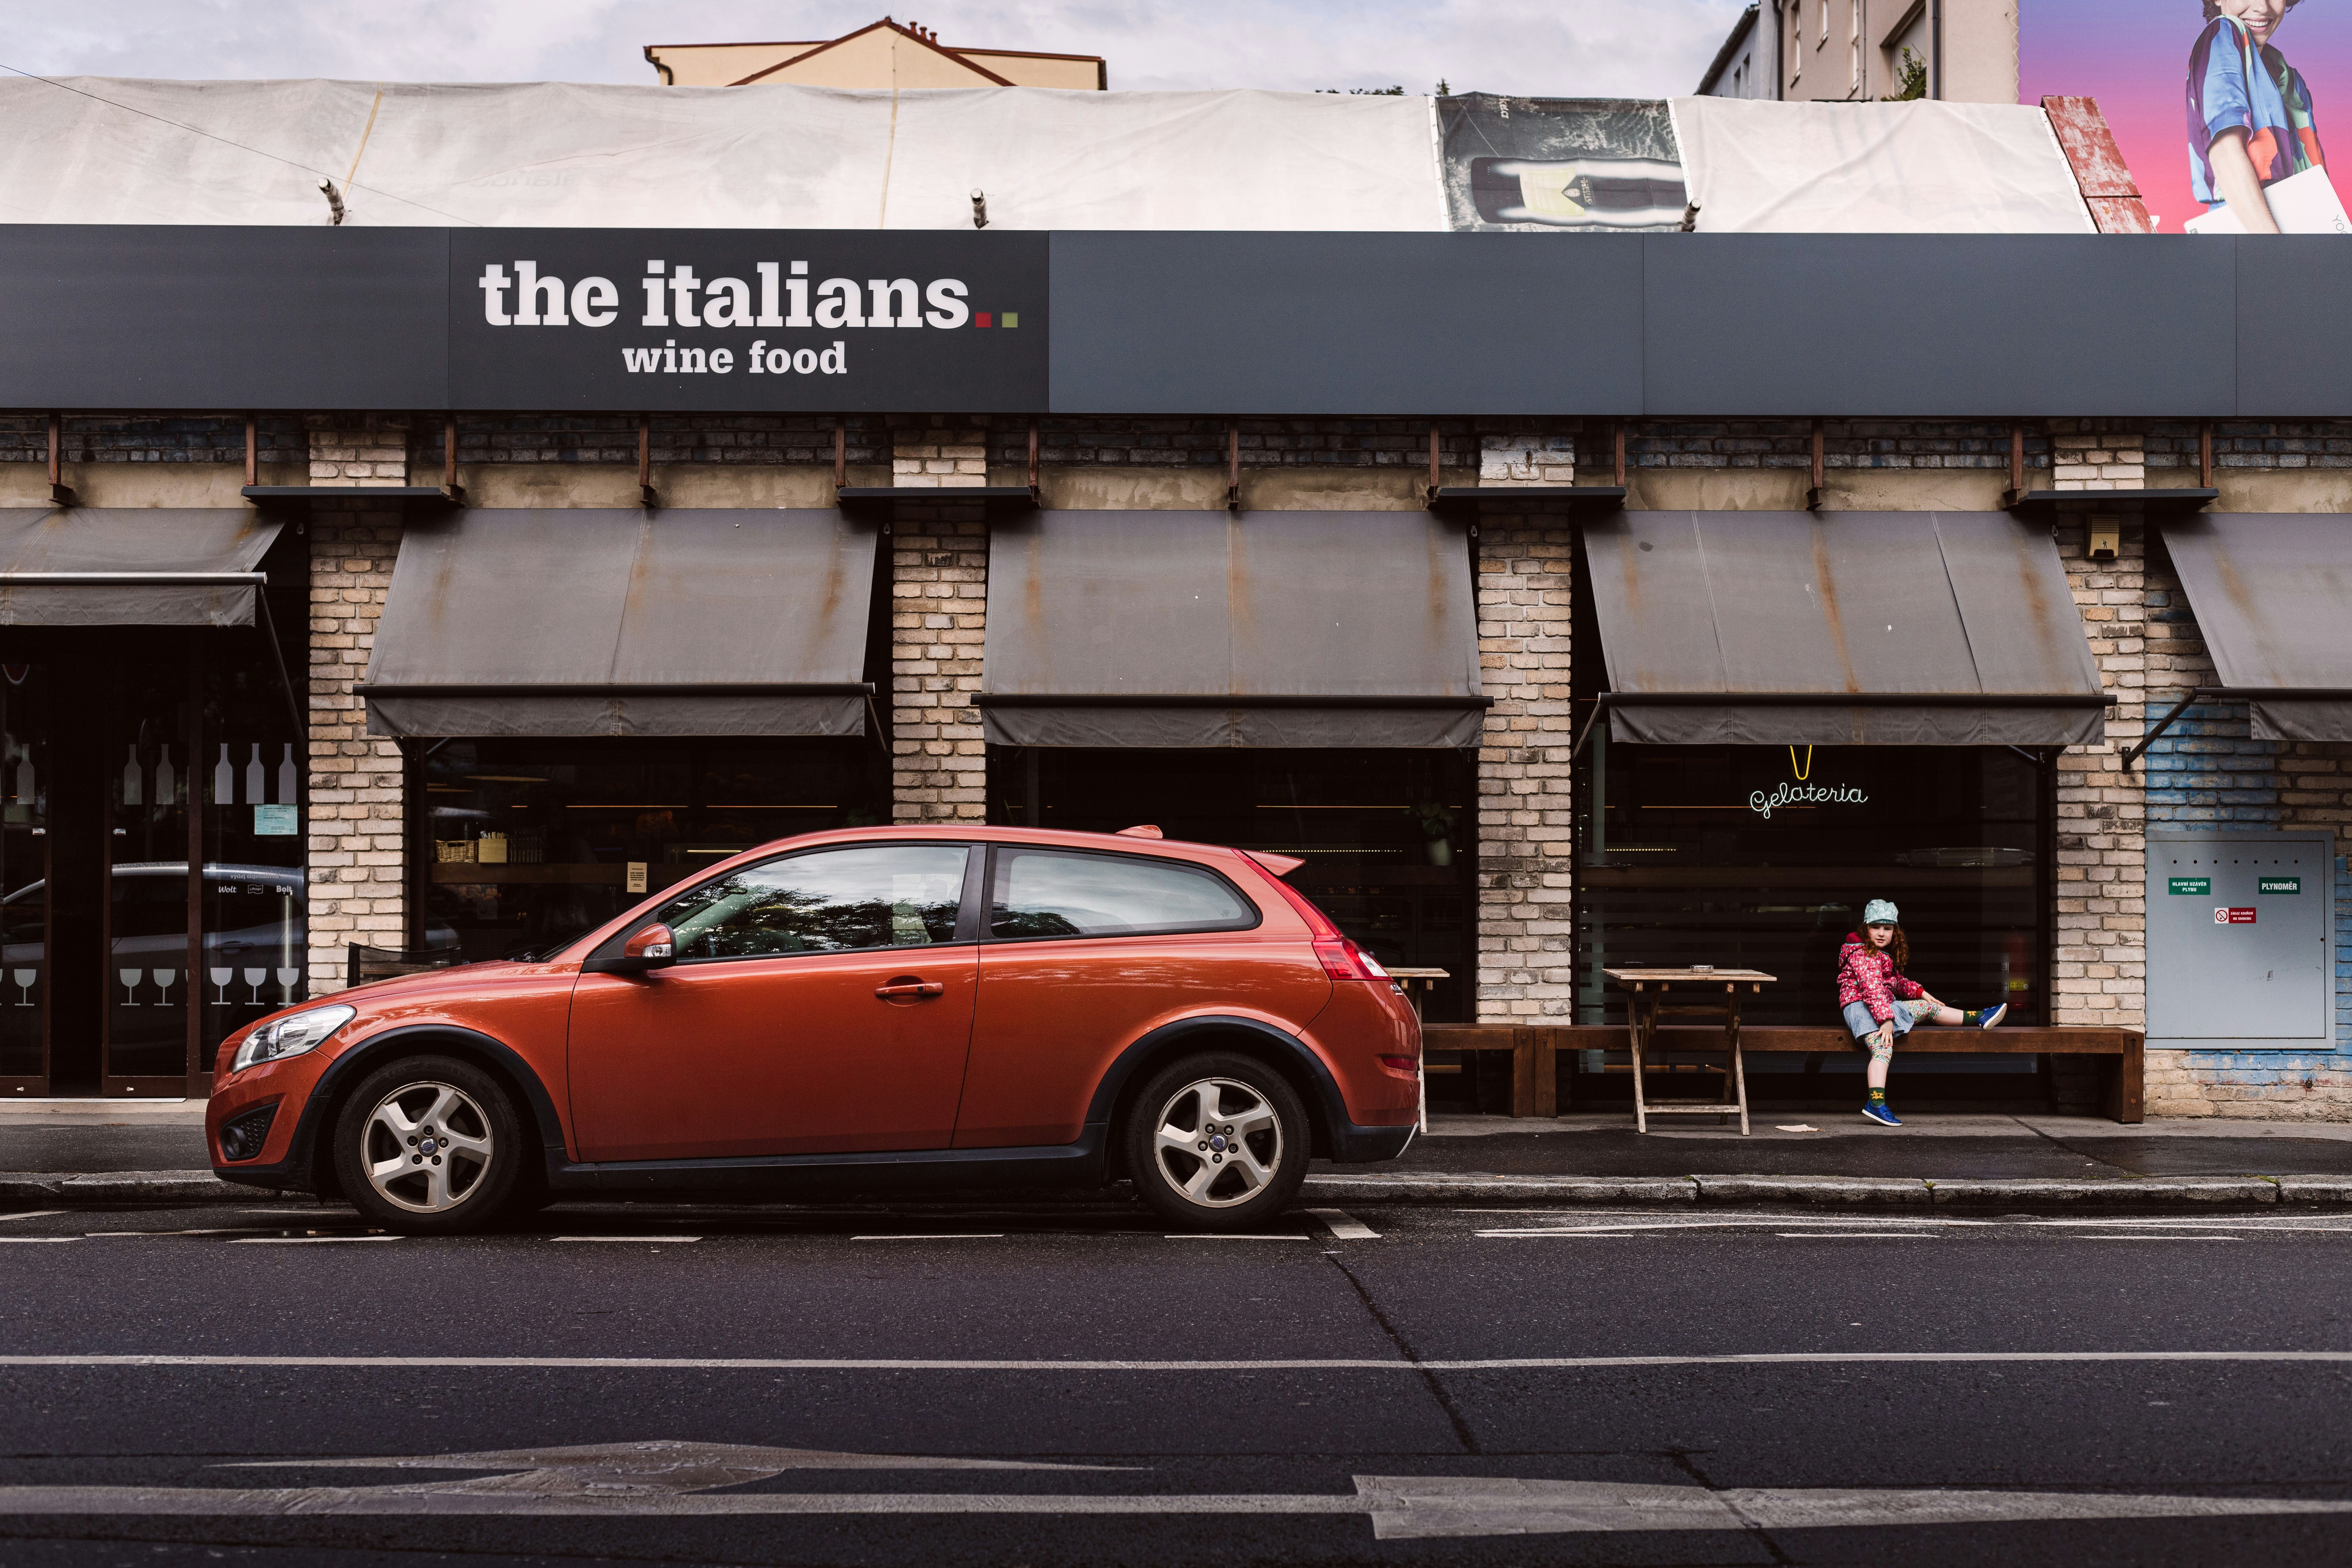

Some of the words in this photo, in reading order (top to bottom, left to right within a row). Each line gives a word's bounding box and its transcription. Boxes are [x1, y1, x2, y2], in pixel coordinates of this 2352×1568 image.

[2332, 214, 2347, 234] YO
[479, 260, 619, 327] the
[622, 339, 733, 374] wine
[749, 340, 847, 374] food
[1750, 782, 1868, 819] Gelateria
[276, 885, 292, 893] Bolt
[2262, 881, 2297, 890] PLYNOMĚR
